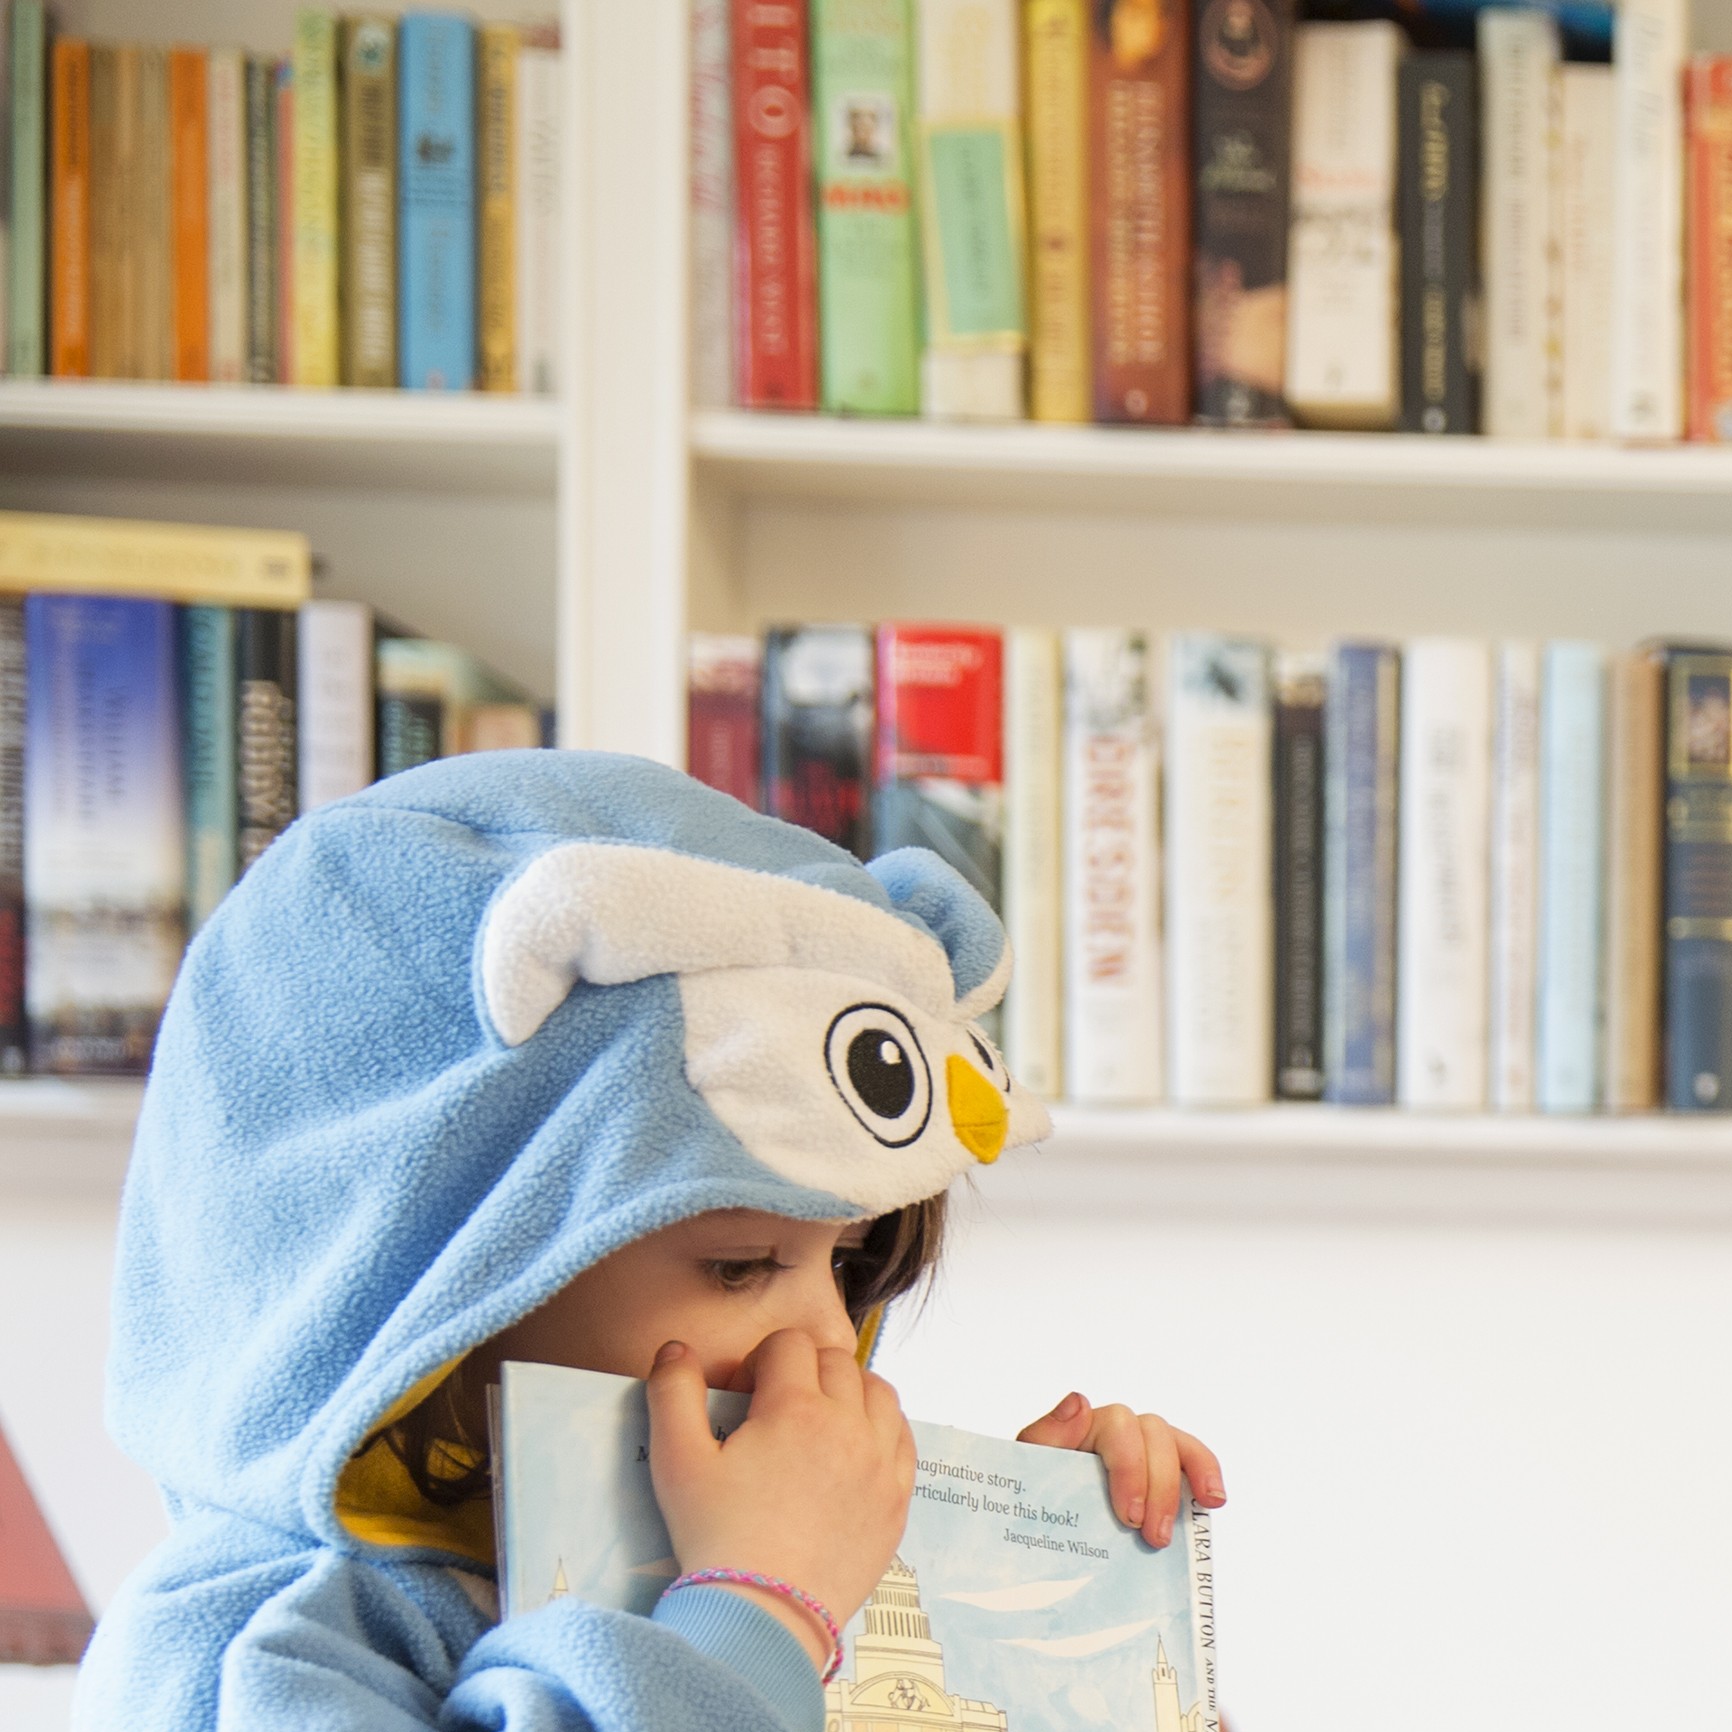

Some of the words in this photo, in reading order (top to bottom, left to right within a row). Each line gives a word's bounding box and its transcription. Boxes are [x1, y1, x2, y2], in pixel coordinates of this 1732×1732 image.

[1081, 734, 1134, 989] DRESDEN
[987, 1472, 1026, 1494] story.
[911, 1484, 979, 1512] rticularly
[983, 1495, 1010, 1515] love
[1013, 1503, 1038, 1521] this
[1041, 1506, 1079, 1528] book!
[1004, 1528, 1065, 1552] Jacqueline
[1067, 1539, 1109, 1560] Wilson
[1197, 1571, 1216, 1650] BUTTON
[1205, 1657, 1216, 1685] AND
[1207, 1687, 1217, 1712] THE
